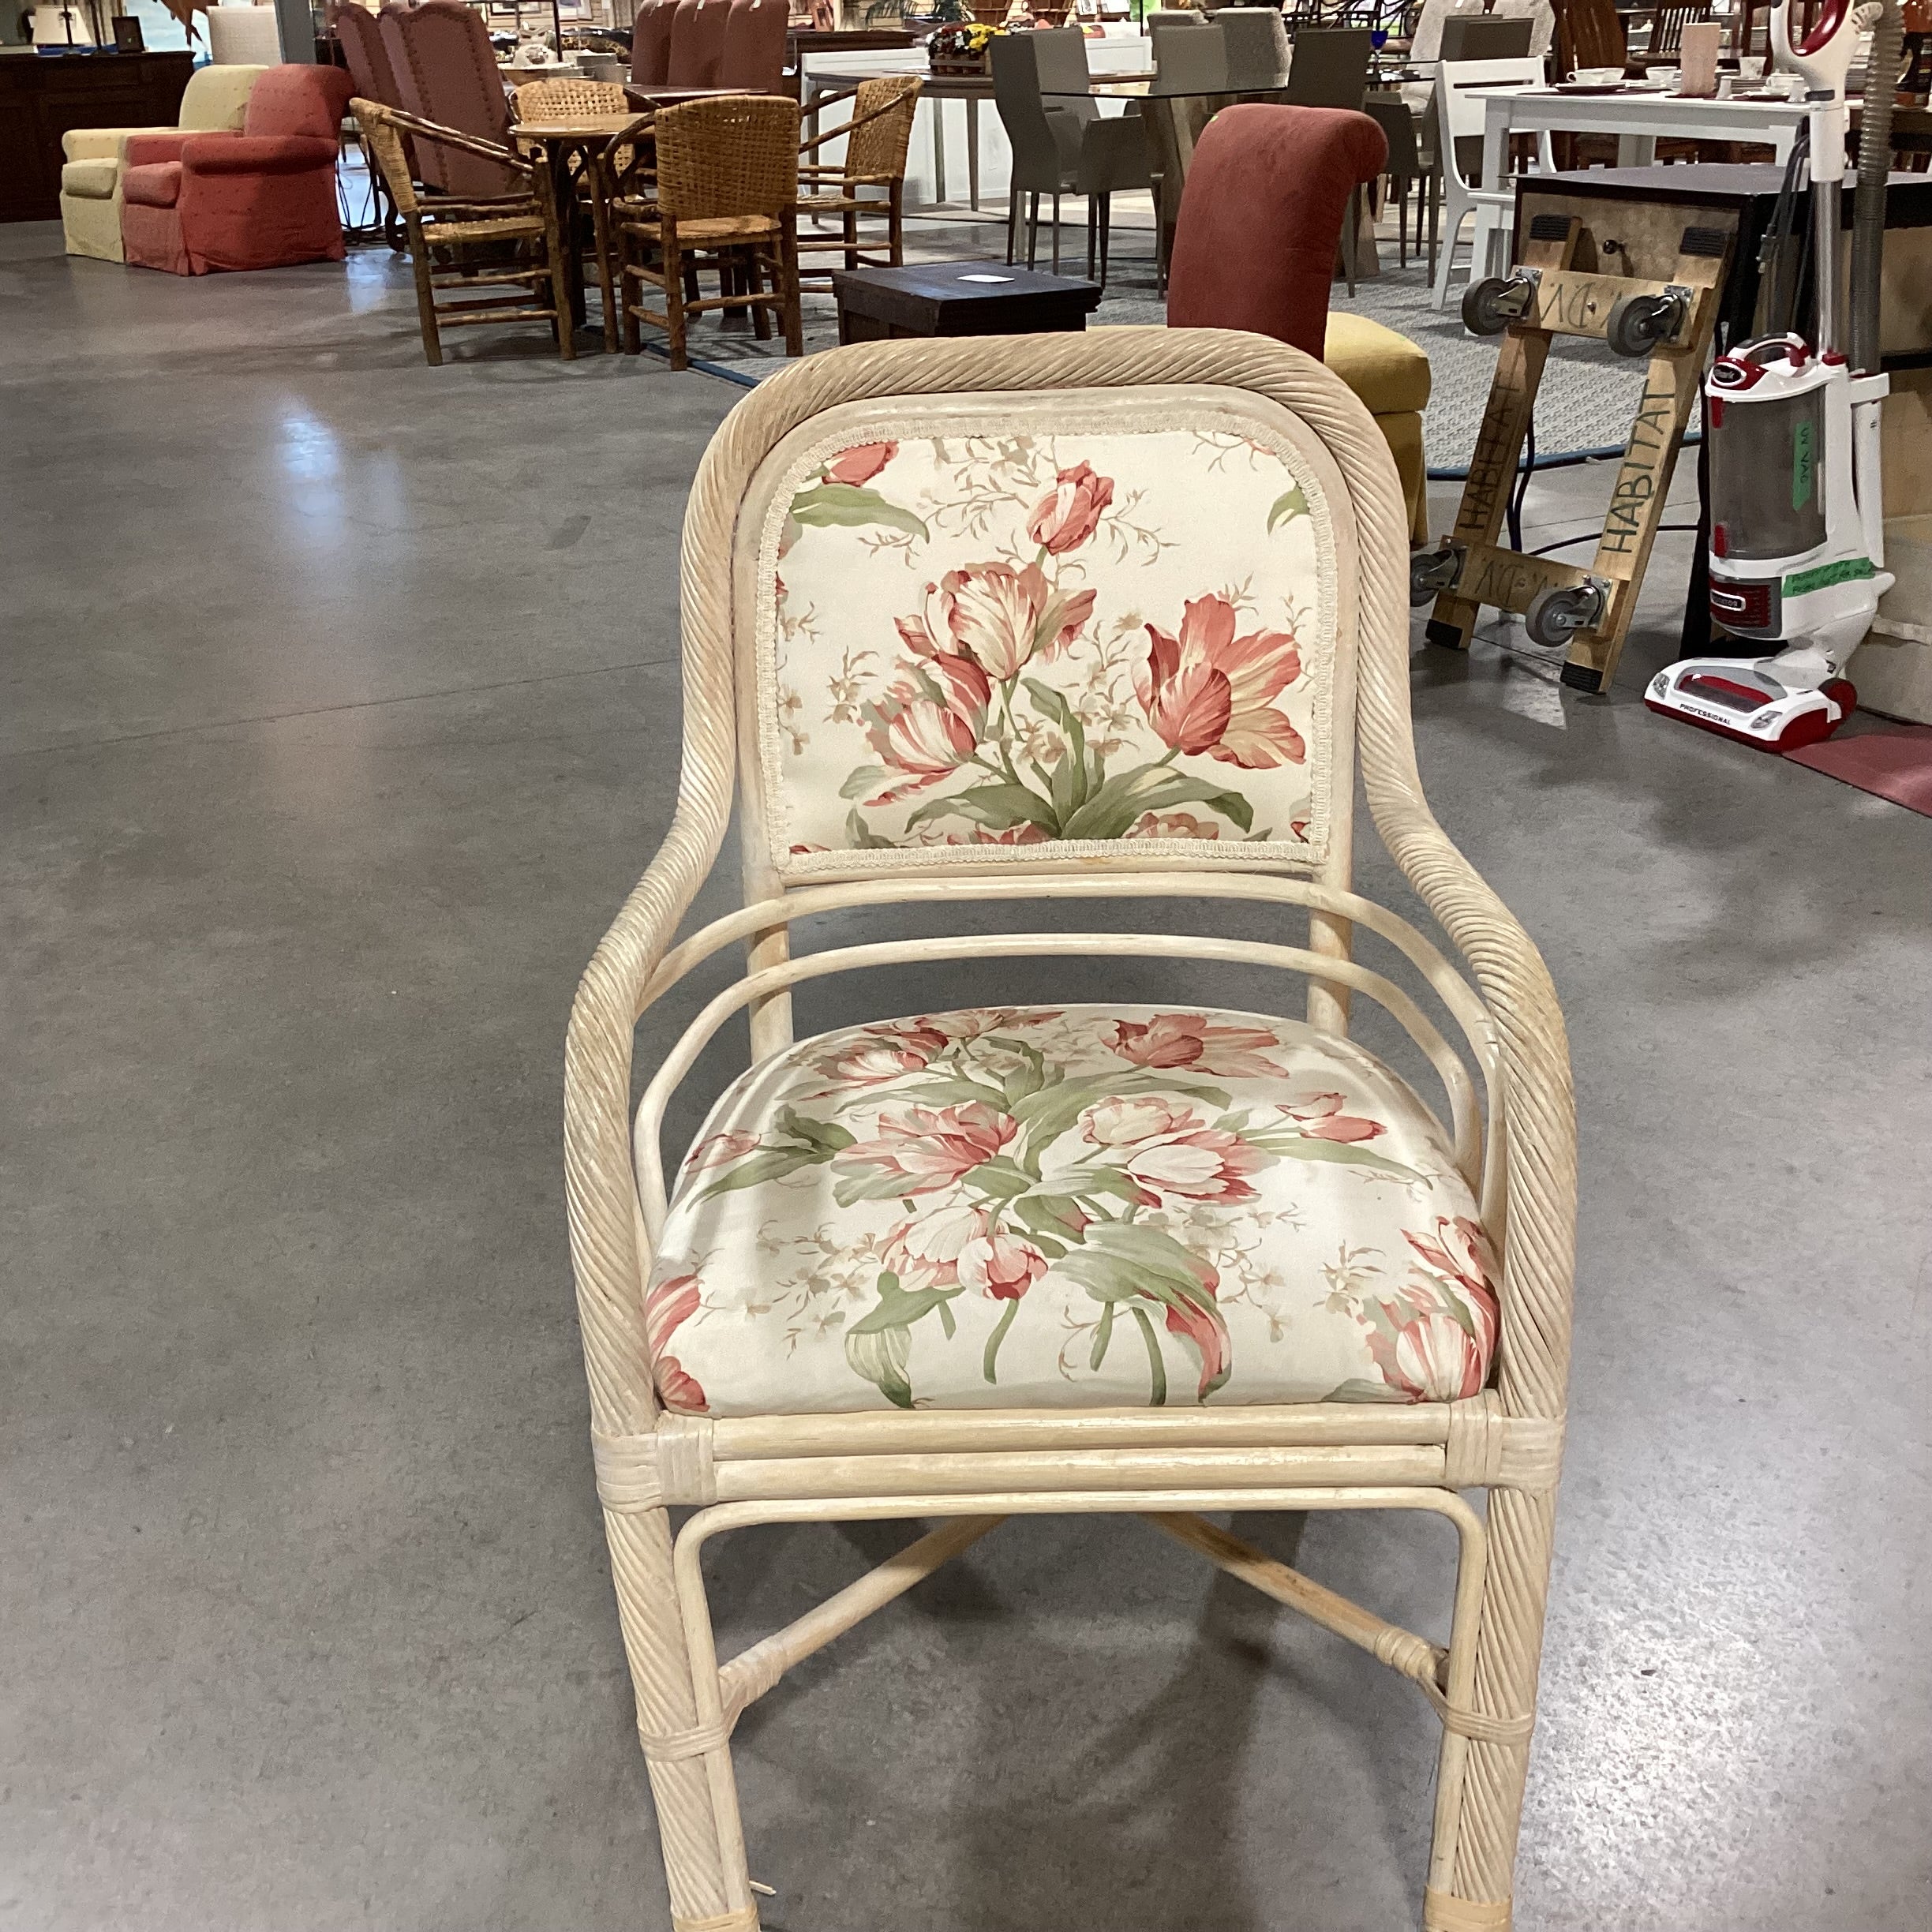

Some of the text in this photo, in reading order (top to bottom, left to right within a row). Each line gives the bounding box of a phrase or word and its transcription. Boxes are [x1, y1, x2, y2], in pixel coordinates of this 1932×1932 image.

[1458, 372, 1520, 529] HABITAT
[1601, 379, 1676, 552] HABITAT
[1679, 703, 1732, 725] PROFESSIONAL
